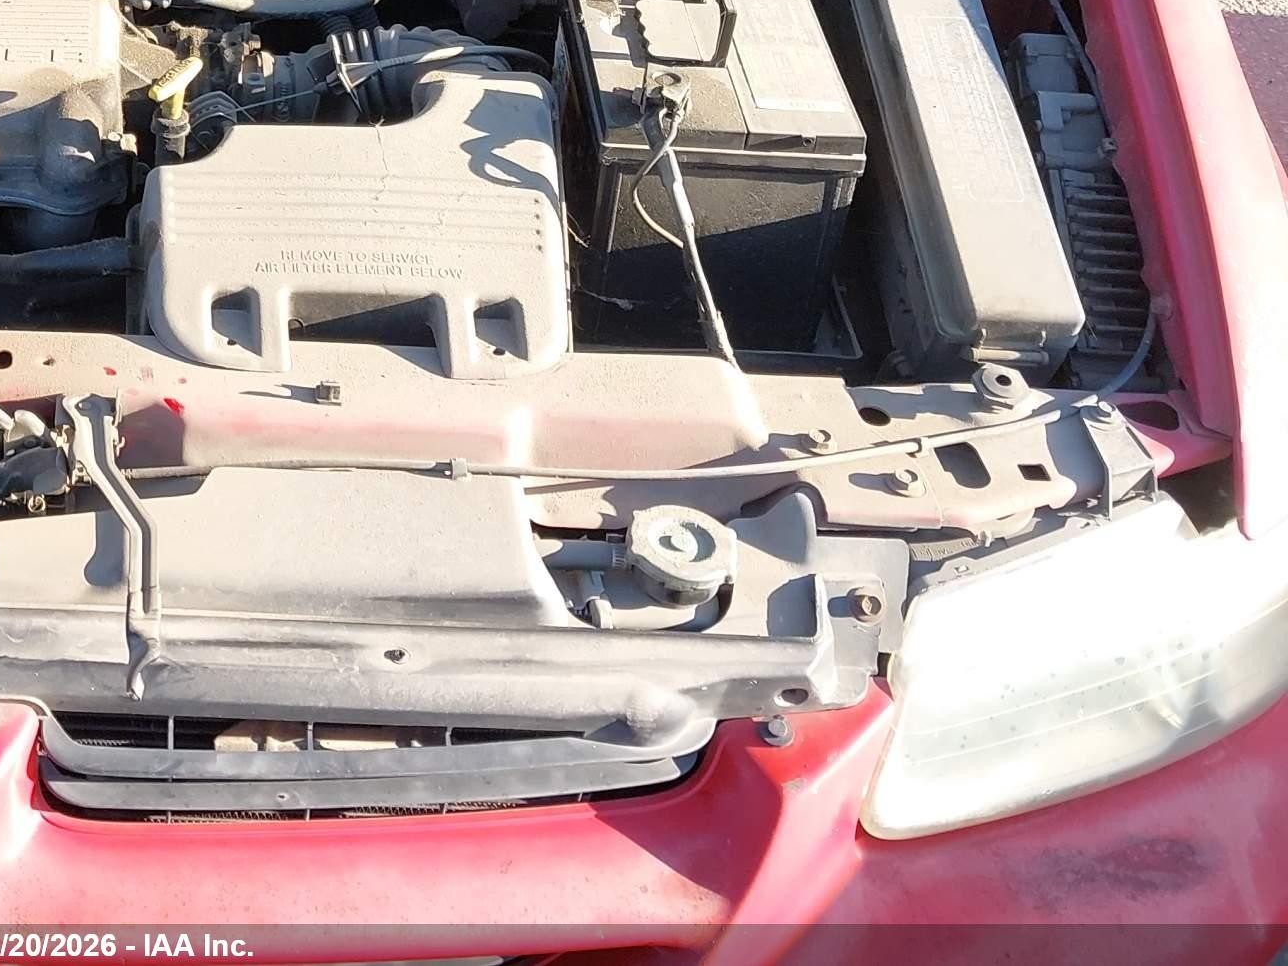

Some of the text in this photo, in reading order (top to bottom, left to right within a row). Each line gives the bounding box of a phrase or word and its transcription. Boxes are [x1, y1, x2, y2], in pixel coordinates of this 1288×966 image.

[280, 249, 433, 265] REMOVE TO SERVICE
[254, 261, 463, 280] AIR FILTER ELEMENT BELOW
